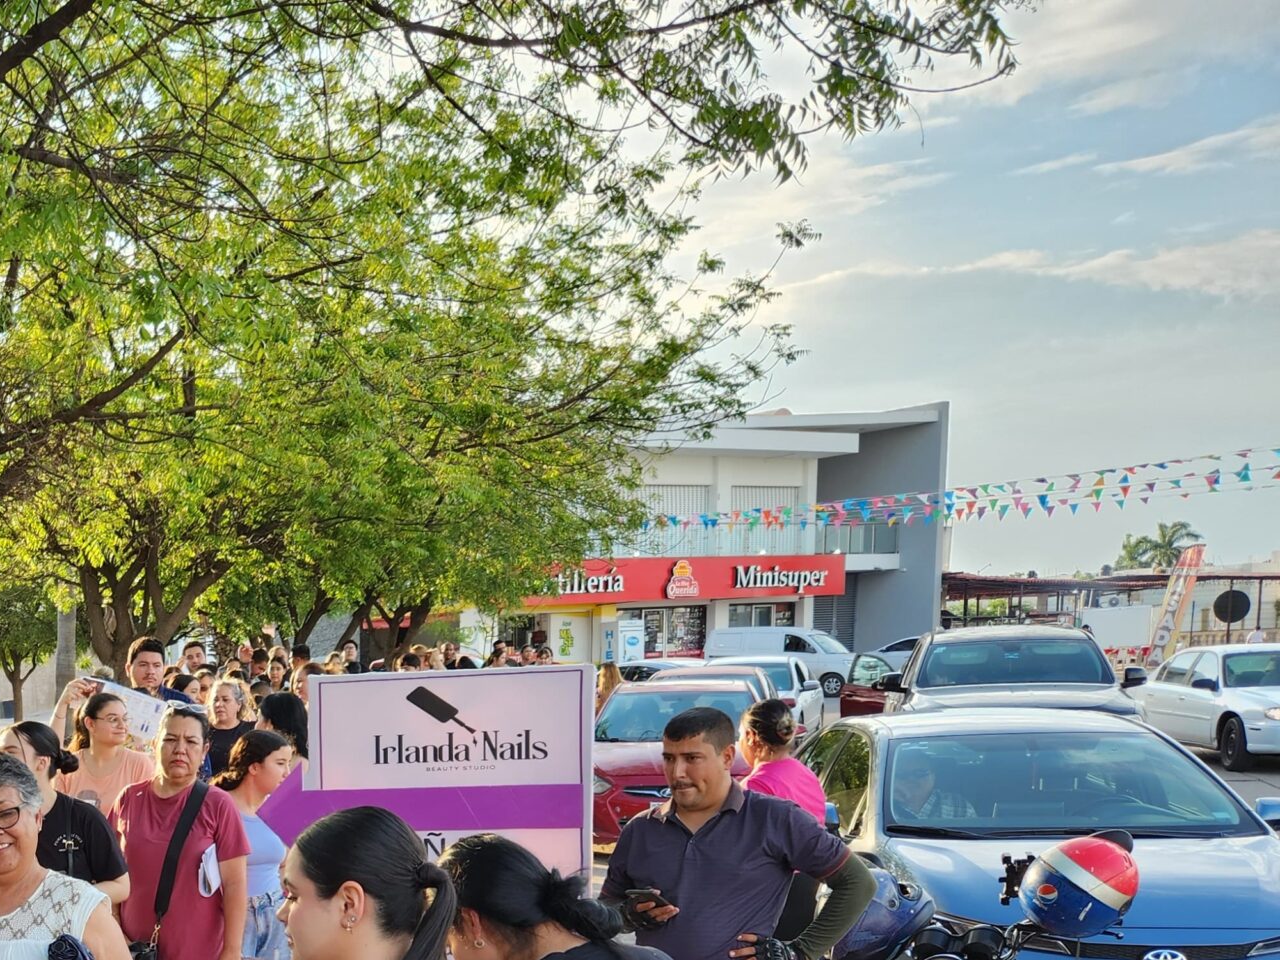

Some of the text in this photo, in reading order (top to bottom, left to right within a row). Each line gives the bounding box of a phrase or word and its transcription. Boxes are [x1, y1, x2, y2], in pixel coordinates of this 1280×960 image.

[550, 567, 624, 595] tillería
[734, 565, 829, 594] Minisuper
[605, 630, 614, 660] HIE
[373, 729, 549, 765] Irlanda Nails
